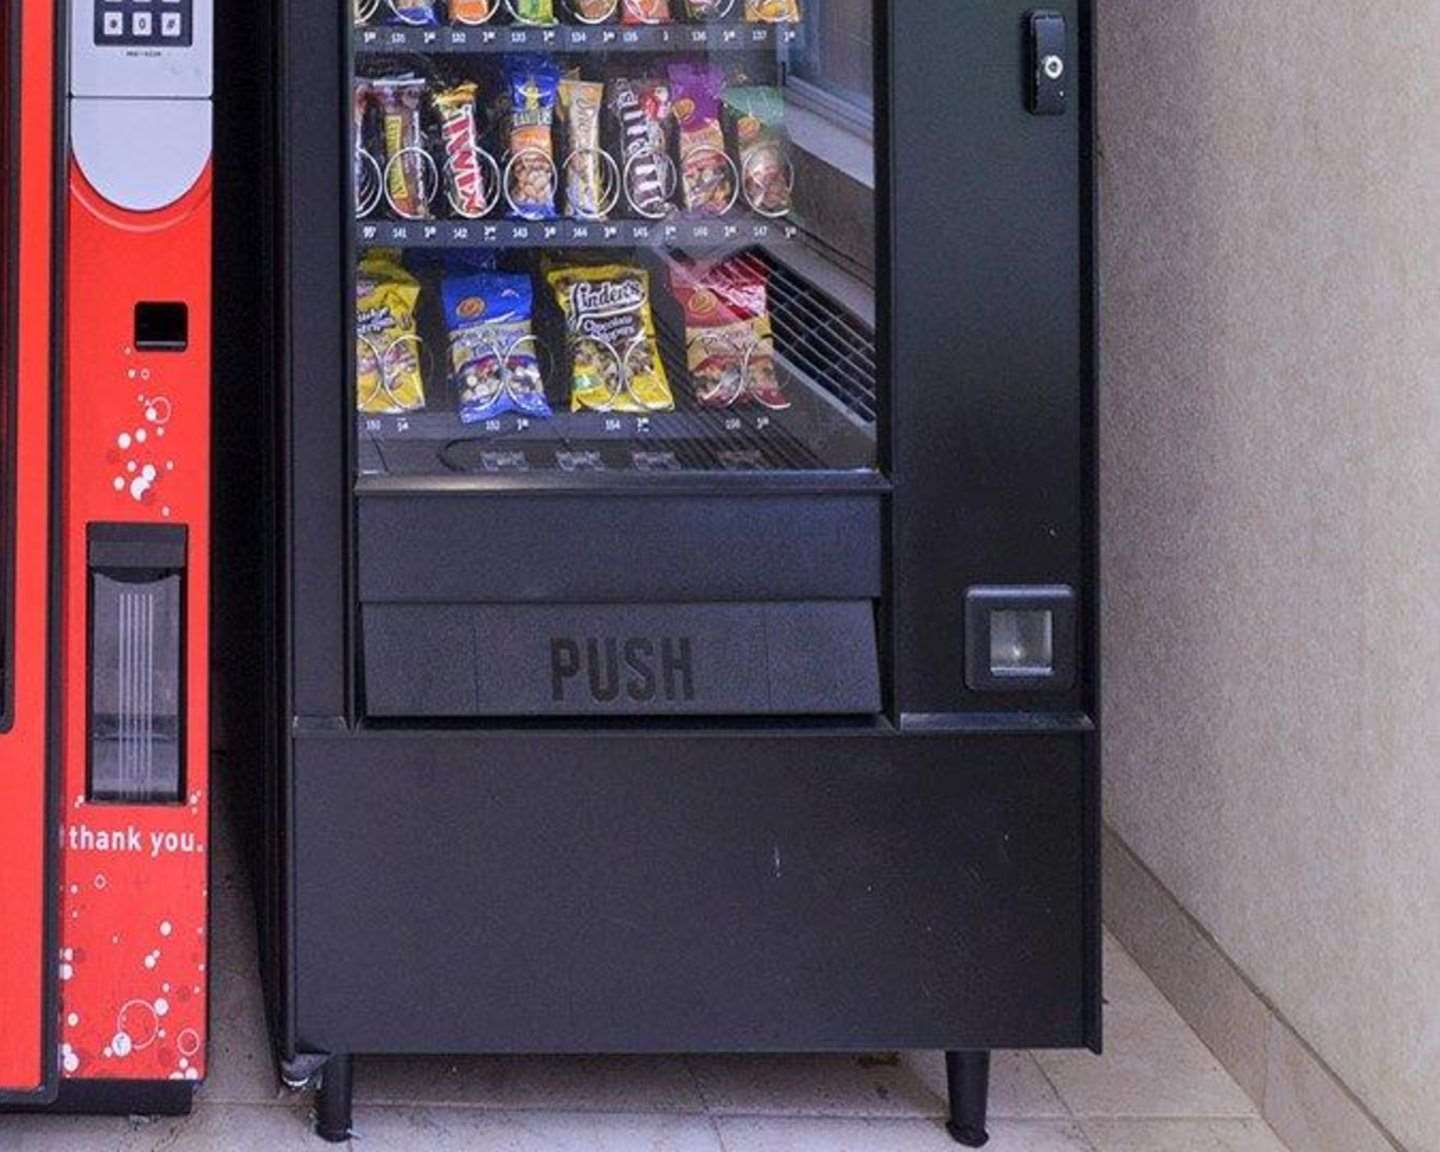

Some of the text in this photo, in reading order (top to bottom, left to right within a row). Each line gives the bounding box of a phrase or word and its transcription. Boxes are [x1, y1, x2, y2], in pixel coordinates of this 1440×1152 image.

[549, 636, 695, 704] PUSH
[69, 824, 204, 858] thank you.
